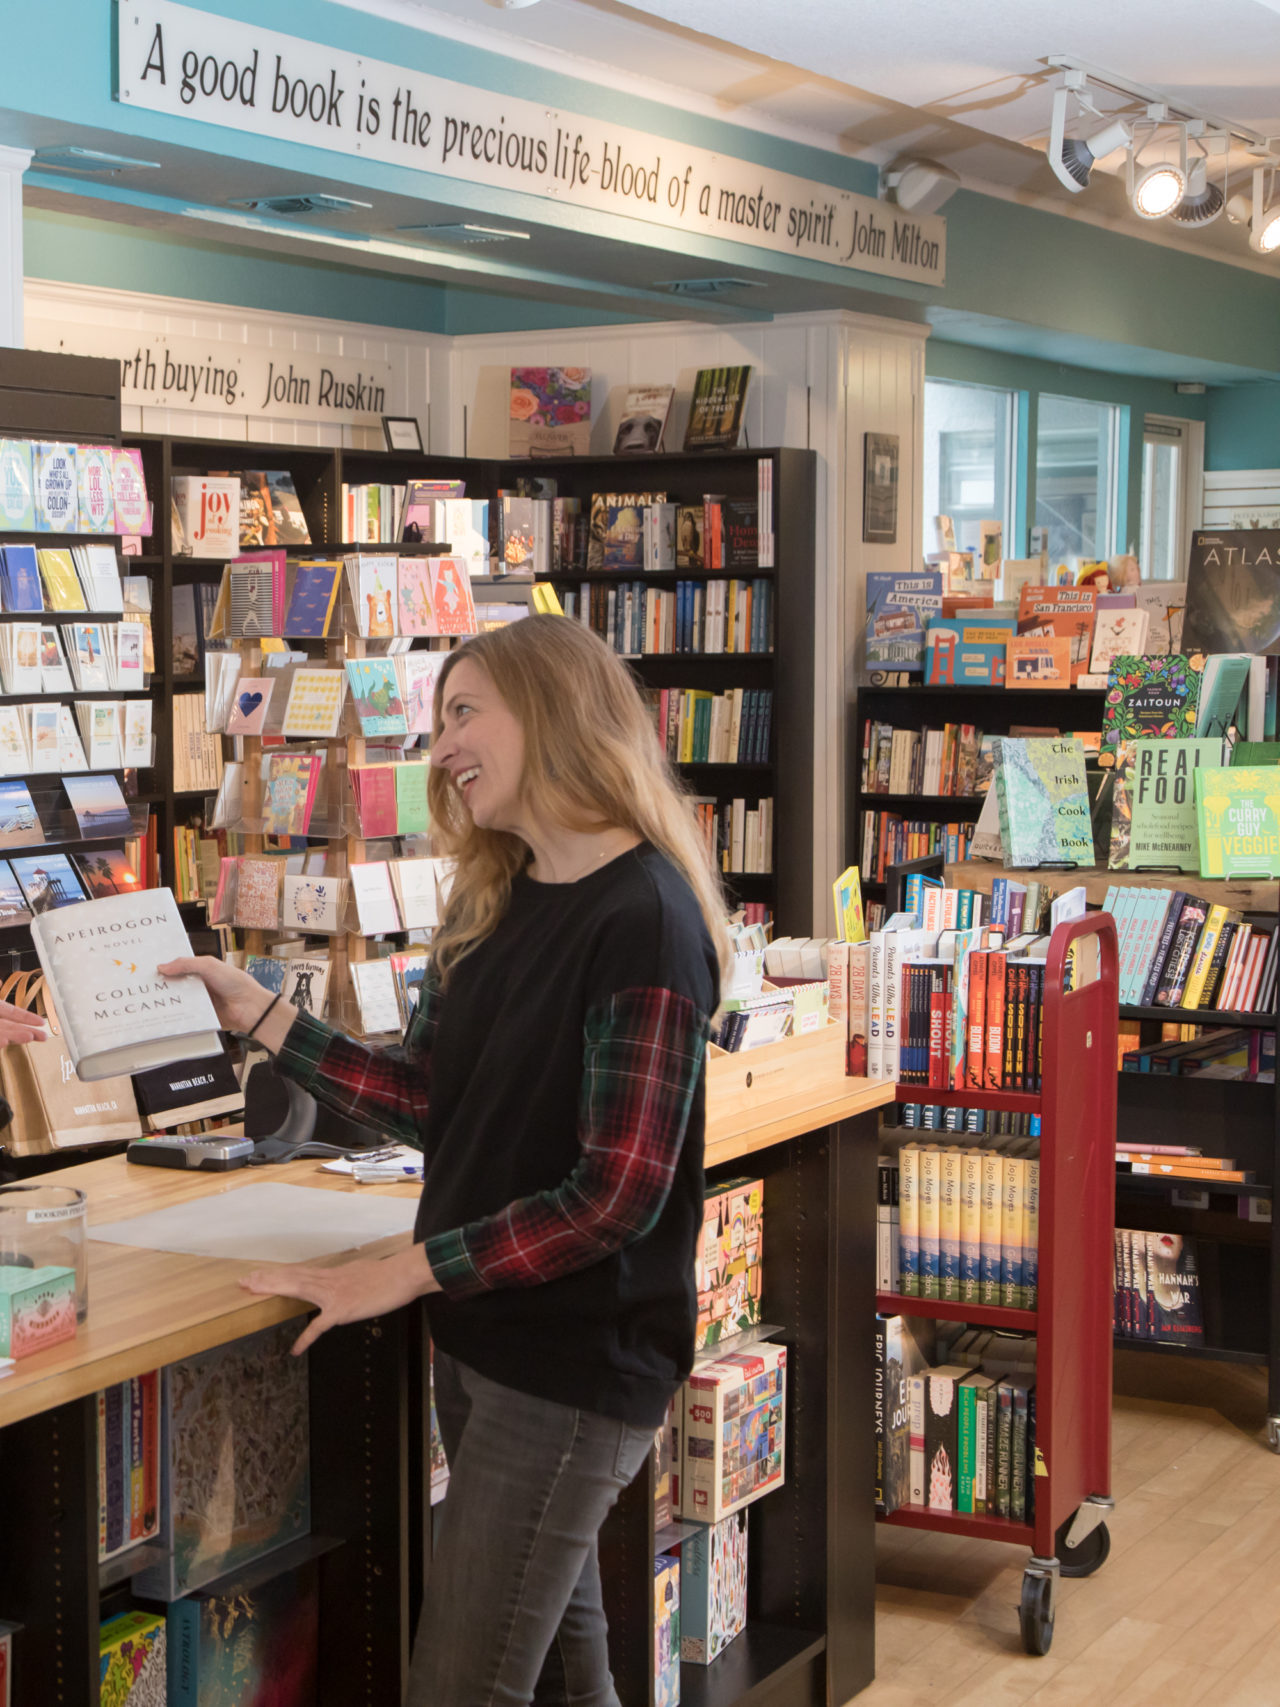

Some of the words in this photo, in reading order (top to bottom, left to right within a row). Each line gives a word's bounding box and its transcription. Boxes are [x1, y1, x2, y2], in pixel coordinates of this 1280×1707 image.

[141, 23, 166, 85] A
[180, 49, 259, 104] good
[272, 55, 345, 128] book
[357, 80, 380, 135] is
[392, 87, 431, 147] the
[442, 115, 548, 174] precious
[554, 129, 660, 203] life-blood
[668, 166, 692, 217] of
[699, 184, 711, 217] a
[718, 186, 781, 234] master
[847, 210, 885, 260] John
[892, 219, 940, 271] Milton
[121, 348, 155, 390] rth
[163, 350, 244, 405] buying.
[262, 363, 310, 409] John
[318, 368, 385, 413] Ruskin
[53, 458, 66, 469] LOOK
[45, 480, 64, 490] GROWN
[65, 480, 72, 490] UP
[194, 483, 234, 540] joy
[896, 581, 918, 590] This
[921, 581, 933, 589] is
[890, 594, 939, 606] America
[1058, 591, 1079, 601] This
[1081, 593, 1091, 601] is
[1034, 603, 1051, 612] San
[1052, 603, 1093, 612] Francisco
[1128, 698, 1181, 707] ZAITOUN
[1052, 744, 1074, 755] The
[1054, 775, 1079, 785] Irish
[1139, 777, 1195, 804] FOO
[1058, 806, 1086, 817] Cook
[1241, 800, 1254, 808] THE
[1228, 808, 1267, 823] CURRY
[1237, 822, 1261, 837] GUY
[1061, 838, 1089, 848] Book
[1136, 842, 1150, 852] MIKE
[927, 892, 937, 931] FACTFULNESS
[54, 914, 168, 944] APEIROGON
[103, 937, 144, 949] NOVEL
[872, 945, 881, 980] Parents
[852, 967, 865, 977] 28
[95, 981, 169, 1002] COLUM
[852, 978, 865, 1001] DAYS
[872, 982, 881, 1007] Who
[871, 1007, 881, 1037] LEAD
[930, 1010, 942, 1058] SHOUT
[970, 1025, 982, 1053] BLOOM
[208, 1074, 215, 1083] CA
[903, 1155, 913, 1173] Jojo
[905, 1176, 913, 1203] Moyes
[35, 1210, 68, 1219] BOOKISH
[1159, 1272, 1199, 1287] HANNAH'S
[1171, 1292, 1190, 1304] WAR
[999, 1423, 1010, 1449] MAZE
[998, 1450, 1010, 1489] RUNNER
